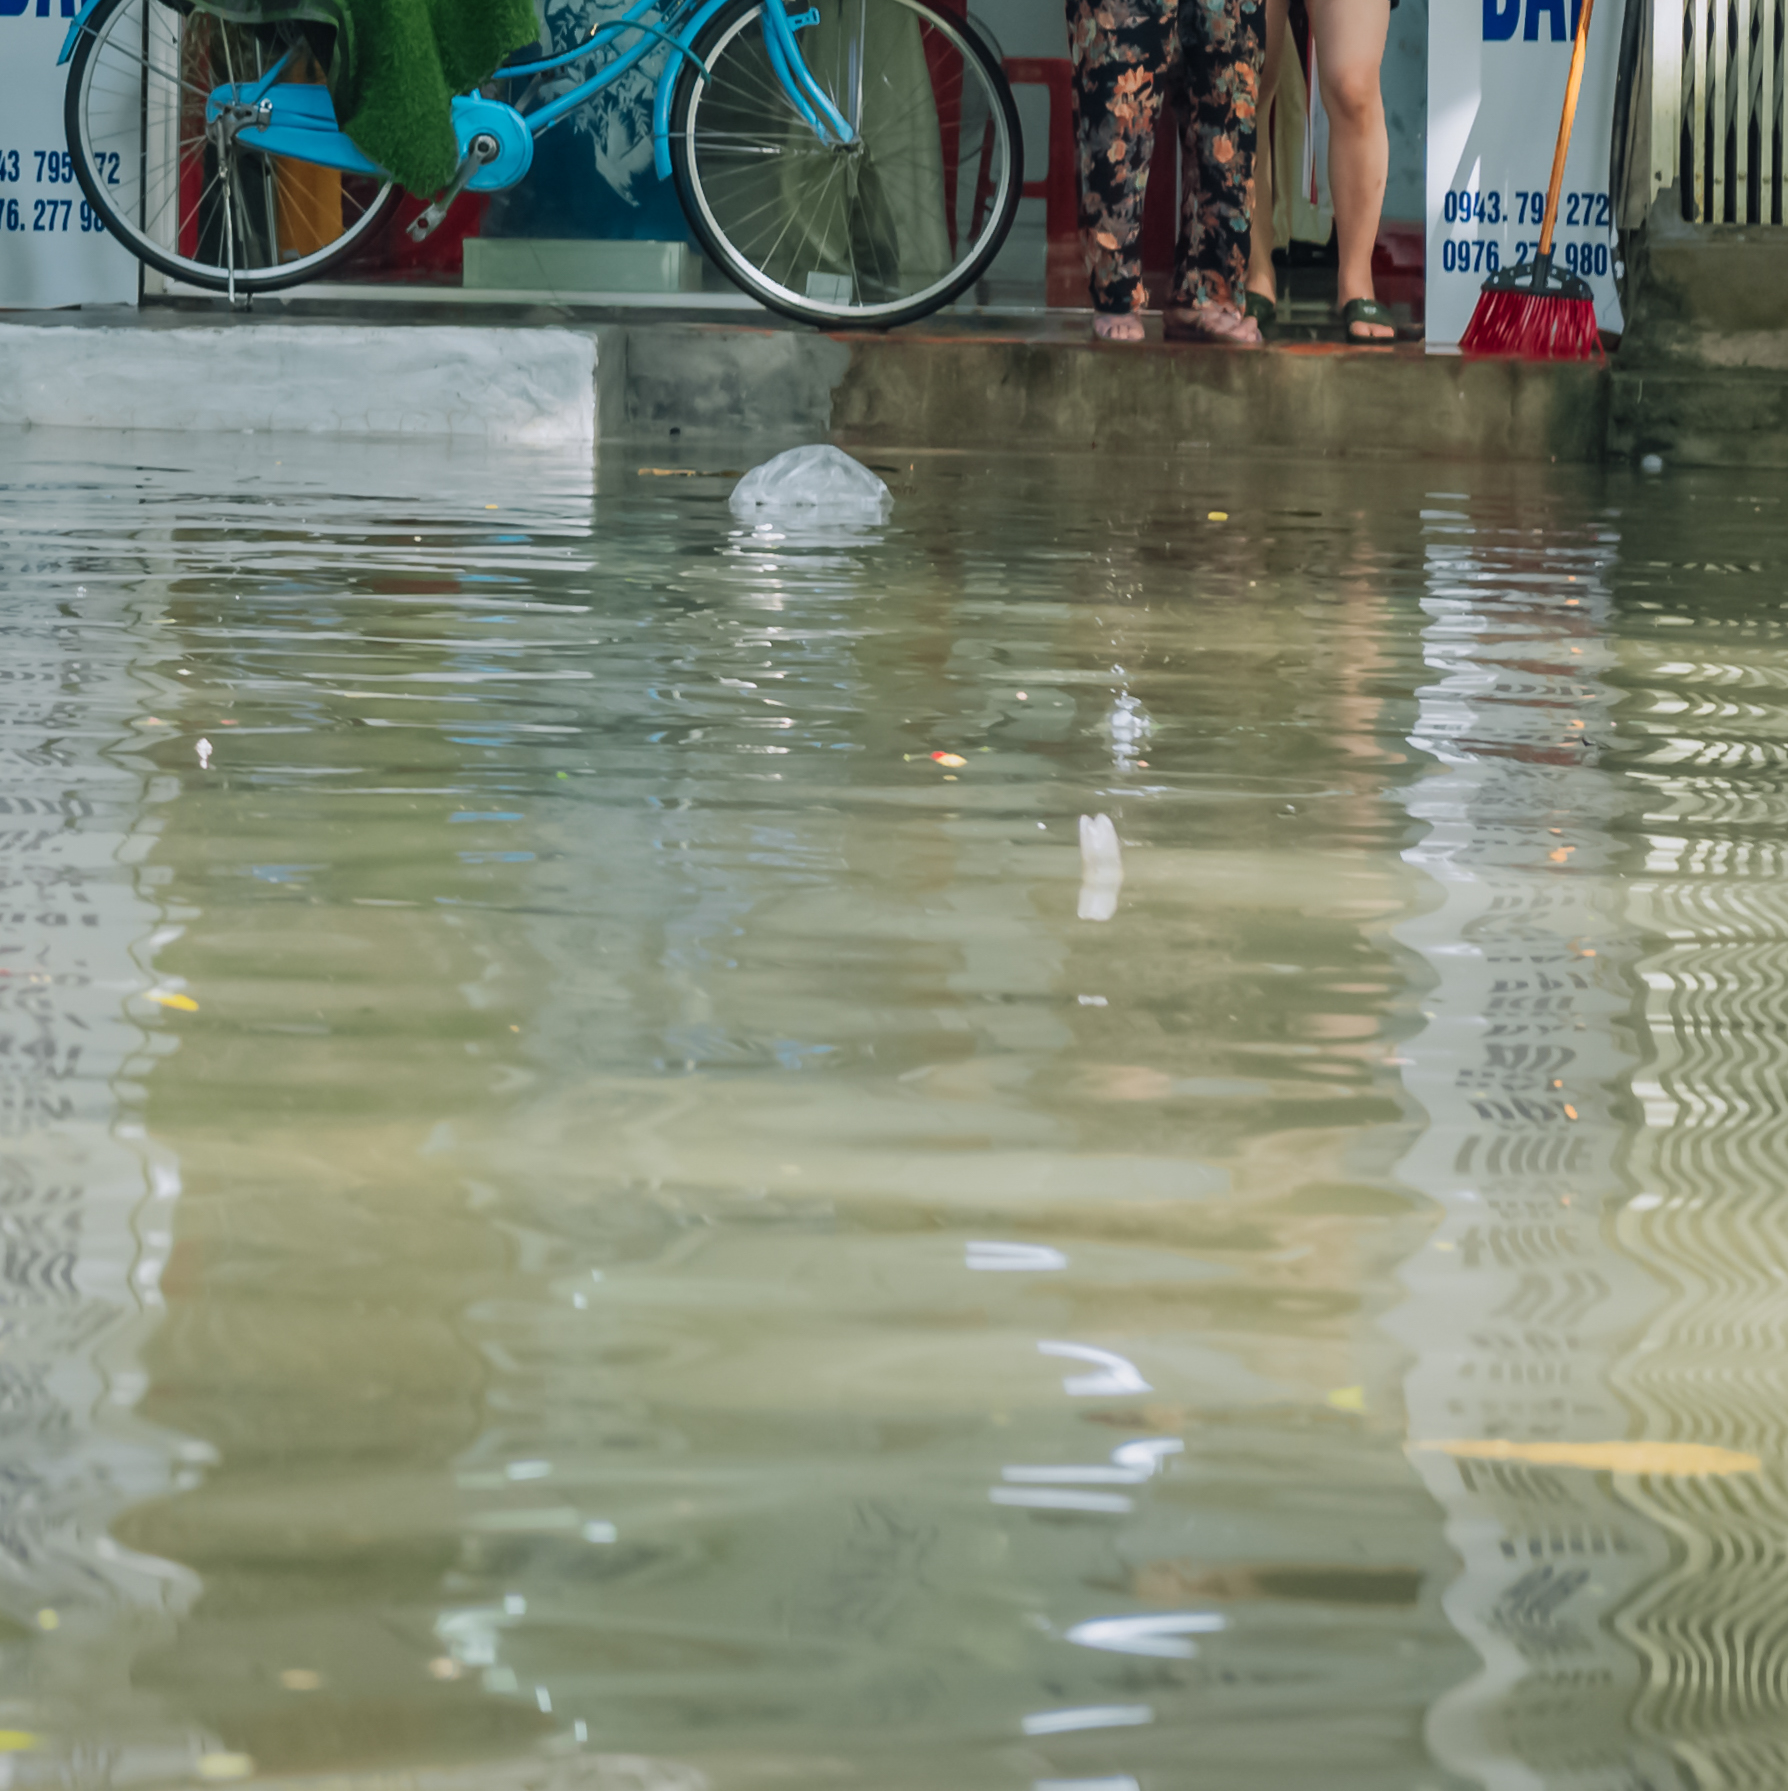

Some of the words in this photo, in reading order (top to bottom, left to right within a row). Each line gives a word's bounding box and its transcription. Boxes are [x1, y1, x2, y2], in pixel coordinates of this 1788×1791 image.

[33, 199, 73, 232] 277
[1444, 190, 1508, 224] 0943.
[1566, 192, 1610, 227] 272
[1565, 242, 1608, 277] 980
